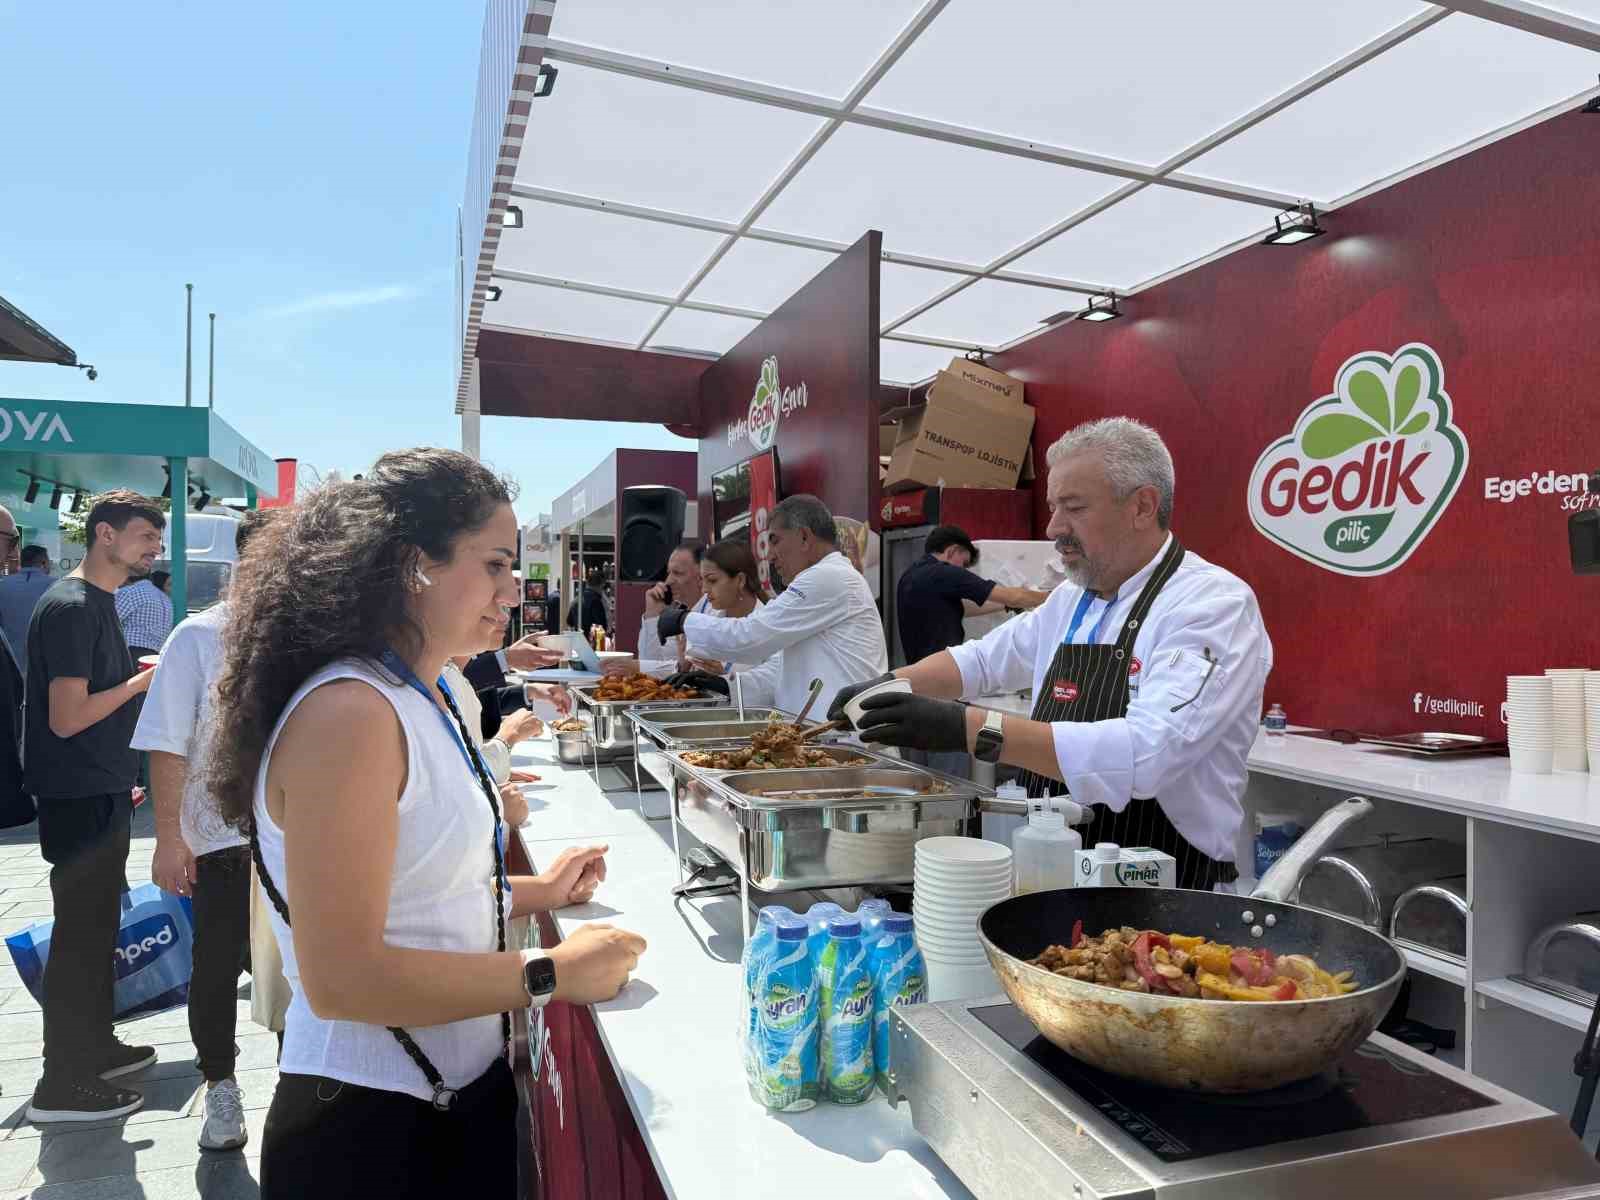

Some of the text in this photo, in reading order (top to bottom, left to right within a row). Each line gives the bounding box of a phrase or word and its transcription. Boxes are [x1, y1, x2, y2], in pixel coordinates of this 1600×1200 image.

[1261, 438, 1432, 517] Gedik
[1484, 470, 1589, 503] Ege'den
[1560, 491, 1600, 512] sofr
[1335, 520, 1371, 546] piliç
[766, 993, 806, 1020] yran
